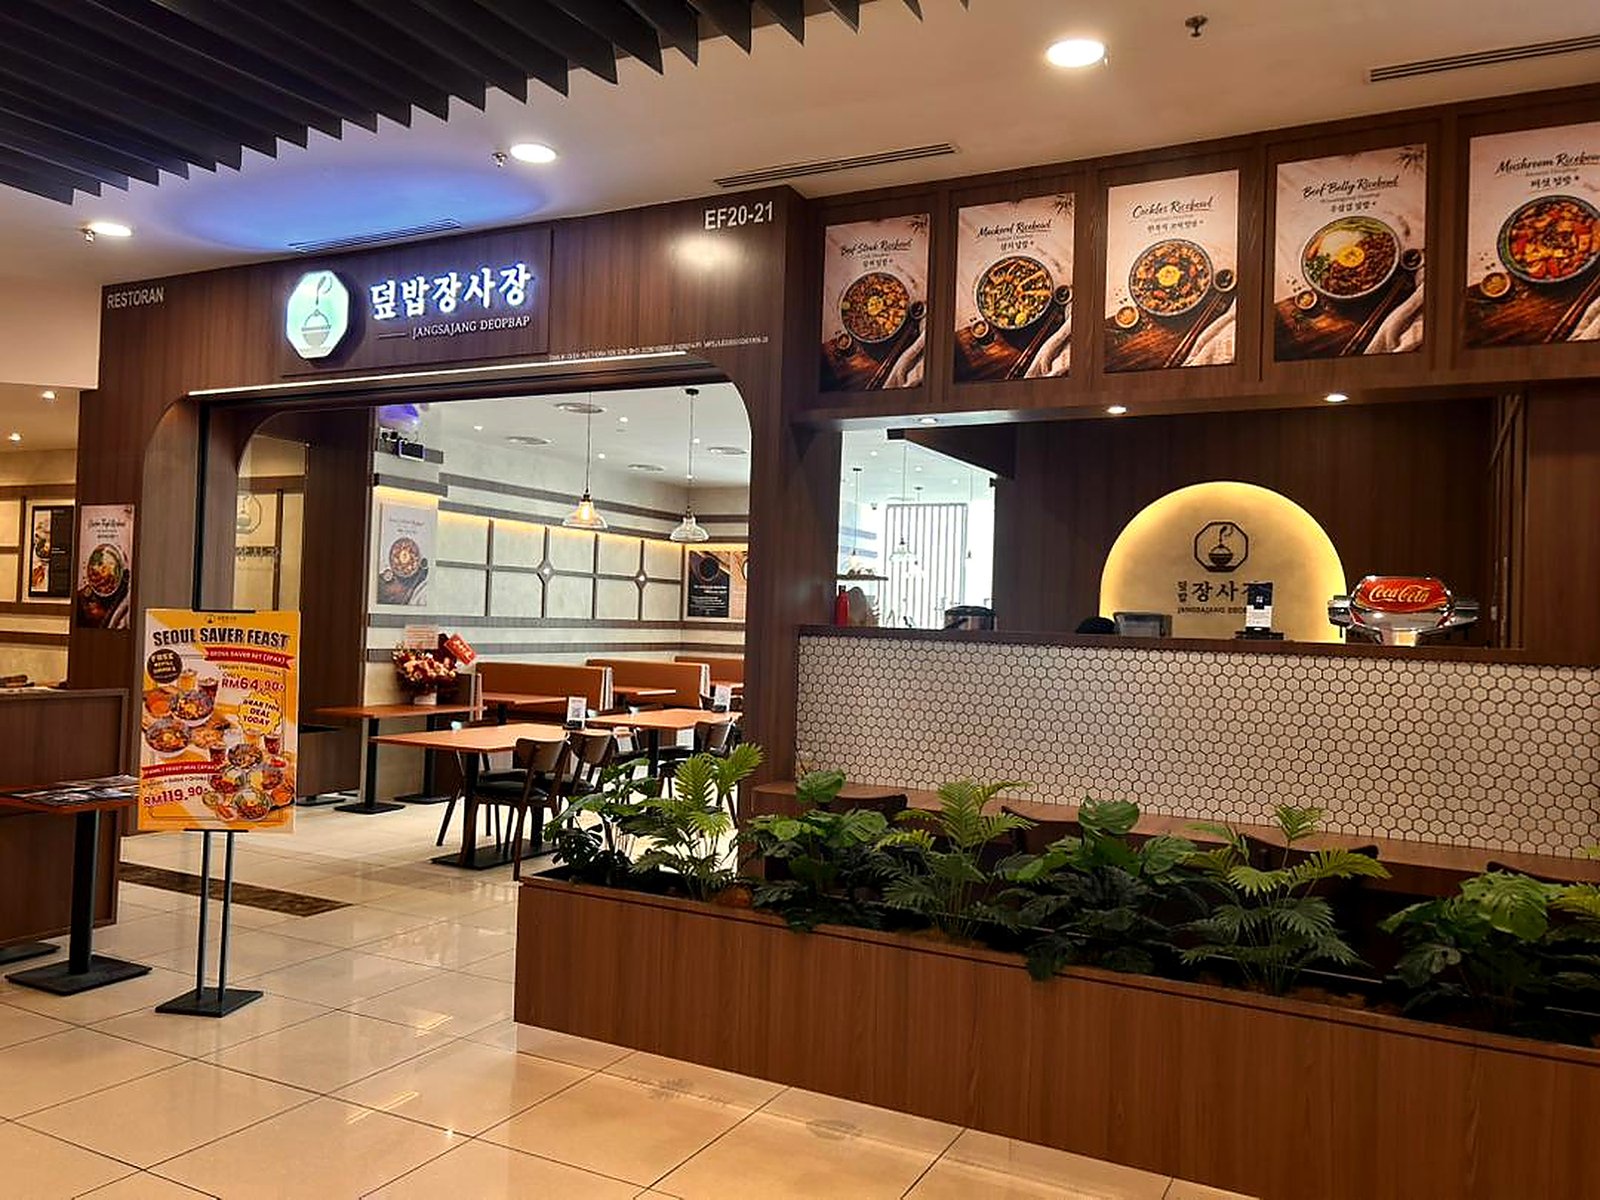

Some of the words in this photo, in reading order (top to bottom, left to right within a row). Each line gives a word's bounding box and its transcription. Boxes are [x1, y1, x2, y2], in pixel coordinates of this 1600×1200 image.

[1494, 157, 1554, 175] Mushroom
[1556, 151, 1600, 166] Ricebow
[1303, 184, 1325, 199] Beef
[704, 201, 773, 230] EF20-21
[1133, 202, 1168, 218] Cockles
[107, 287, 164, 309] RESTORAN
[370, 263, 531, 320] 덮밥장사장
[412, 320, 477, 340] JANGSAJANG
[480, 316, 530, 330] DEOPBAP
[153, 628, 196, 646] SEOUL
[200, 627, 245, 643] SAVER
[247, 630, 290, 648] FEAST
[243, 715, 270, 726] TODAY
